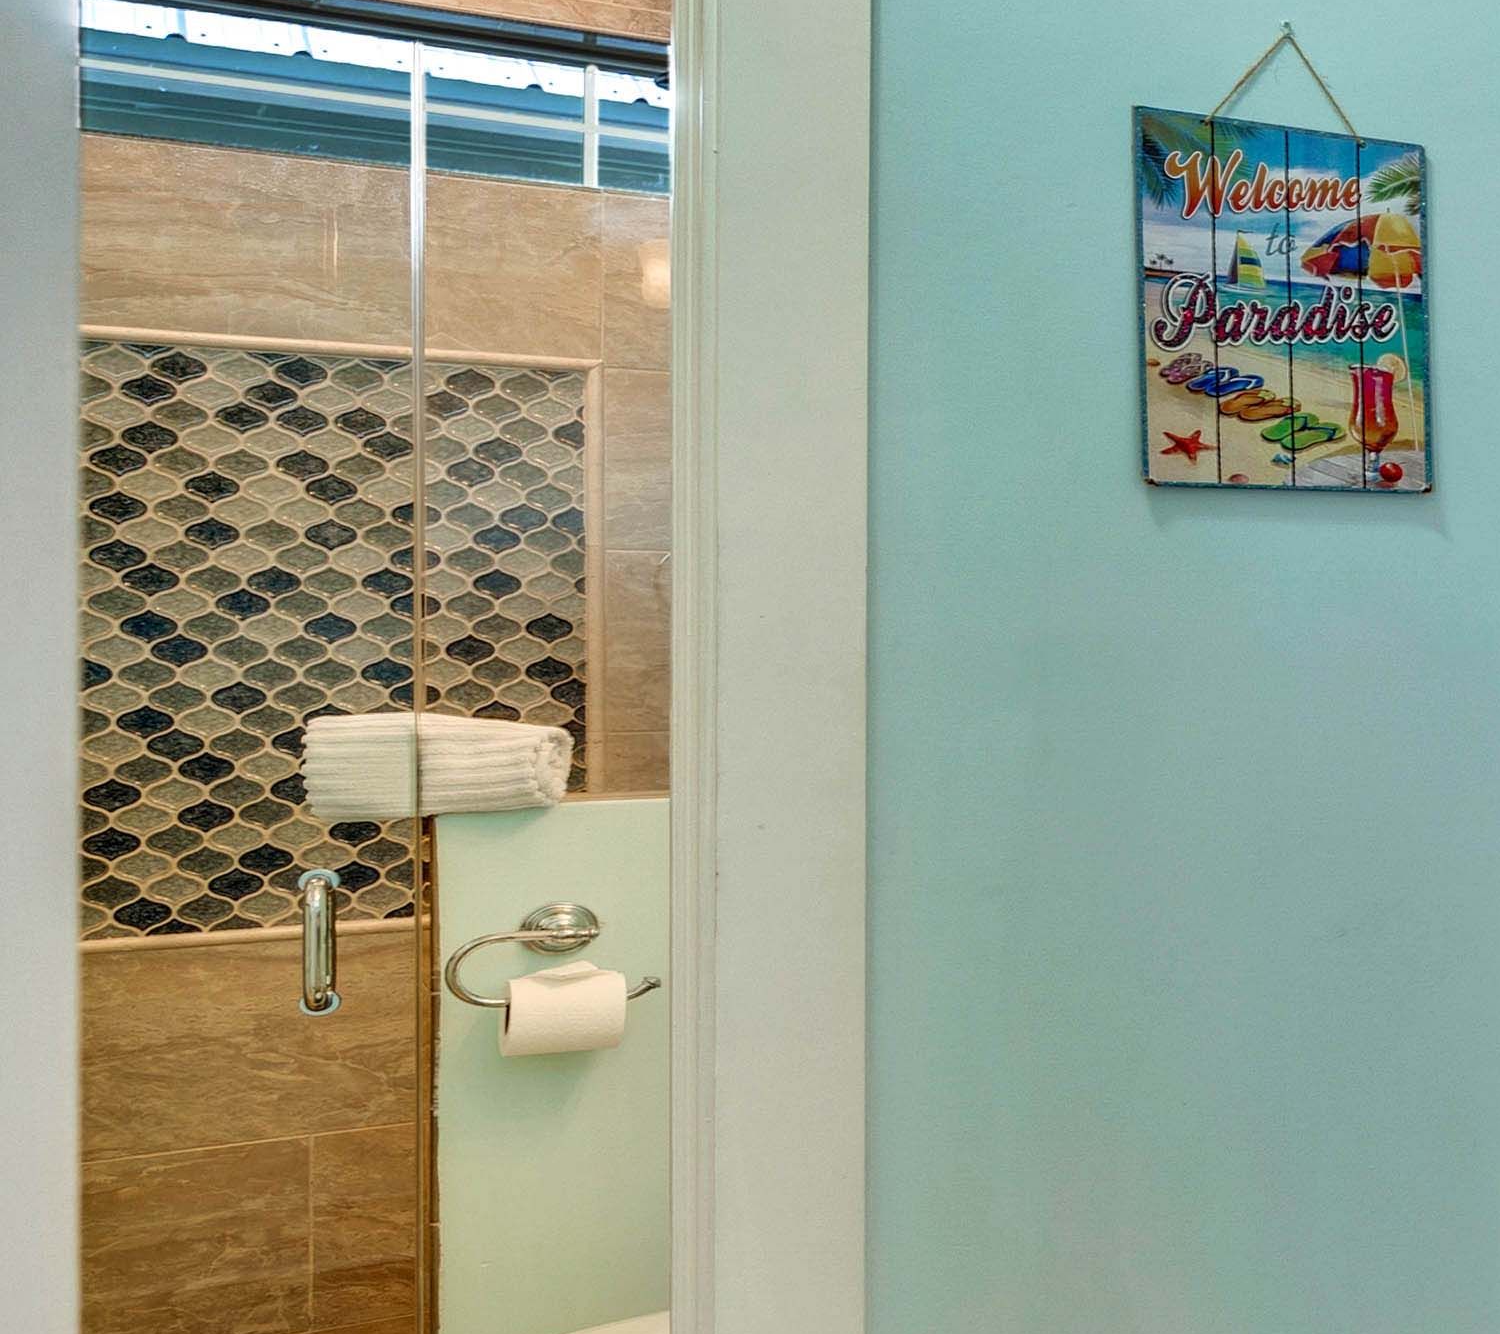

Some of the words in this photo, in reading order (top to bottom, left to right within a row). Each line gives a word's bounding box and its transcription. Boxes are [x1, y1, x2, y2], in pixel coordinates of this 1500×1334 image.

[1165, 149, 1362, 219] Welcome
[1265, 223, 1297, 256] to
[1153, 273, 1399, 350] Paradise
